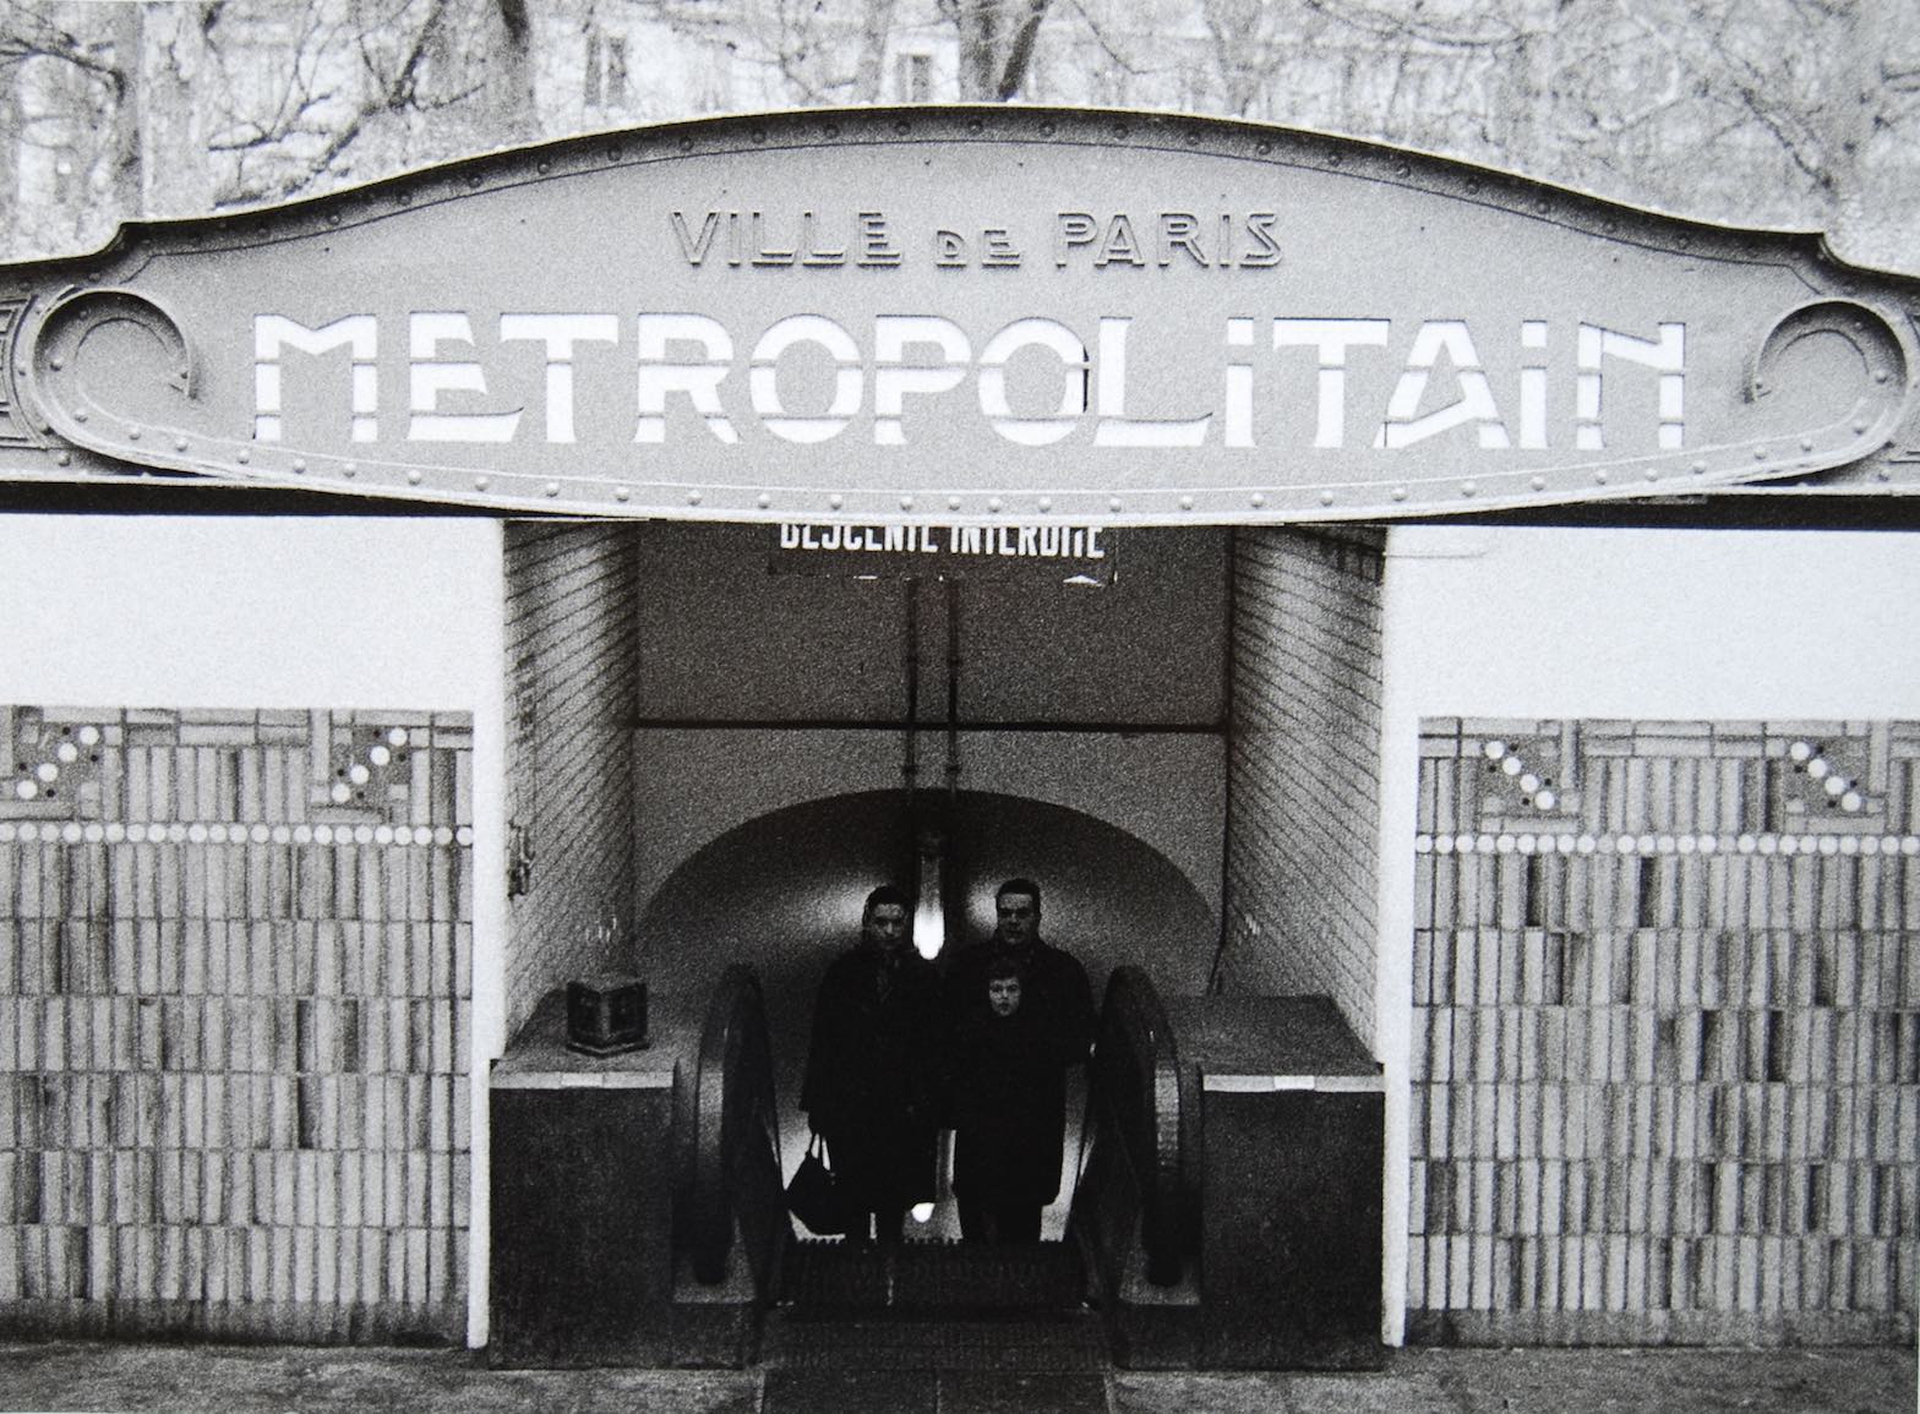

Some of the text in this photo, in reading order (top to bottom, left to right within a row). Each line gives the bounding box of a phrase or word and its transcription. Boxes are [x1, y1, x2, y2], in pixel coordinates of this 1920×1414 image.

[673, 211, 1282, 268] VILLE DE PARIS
